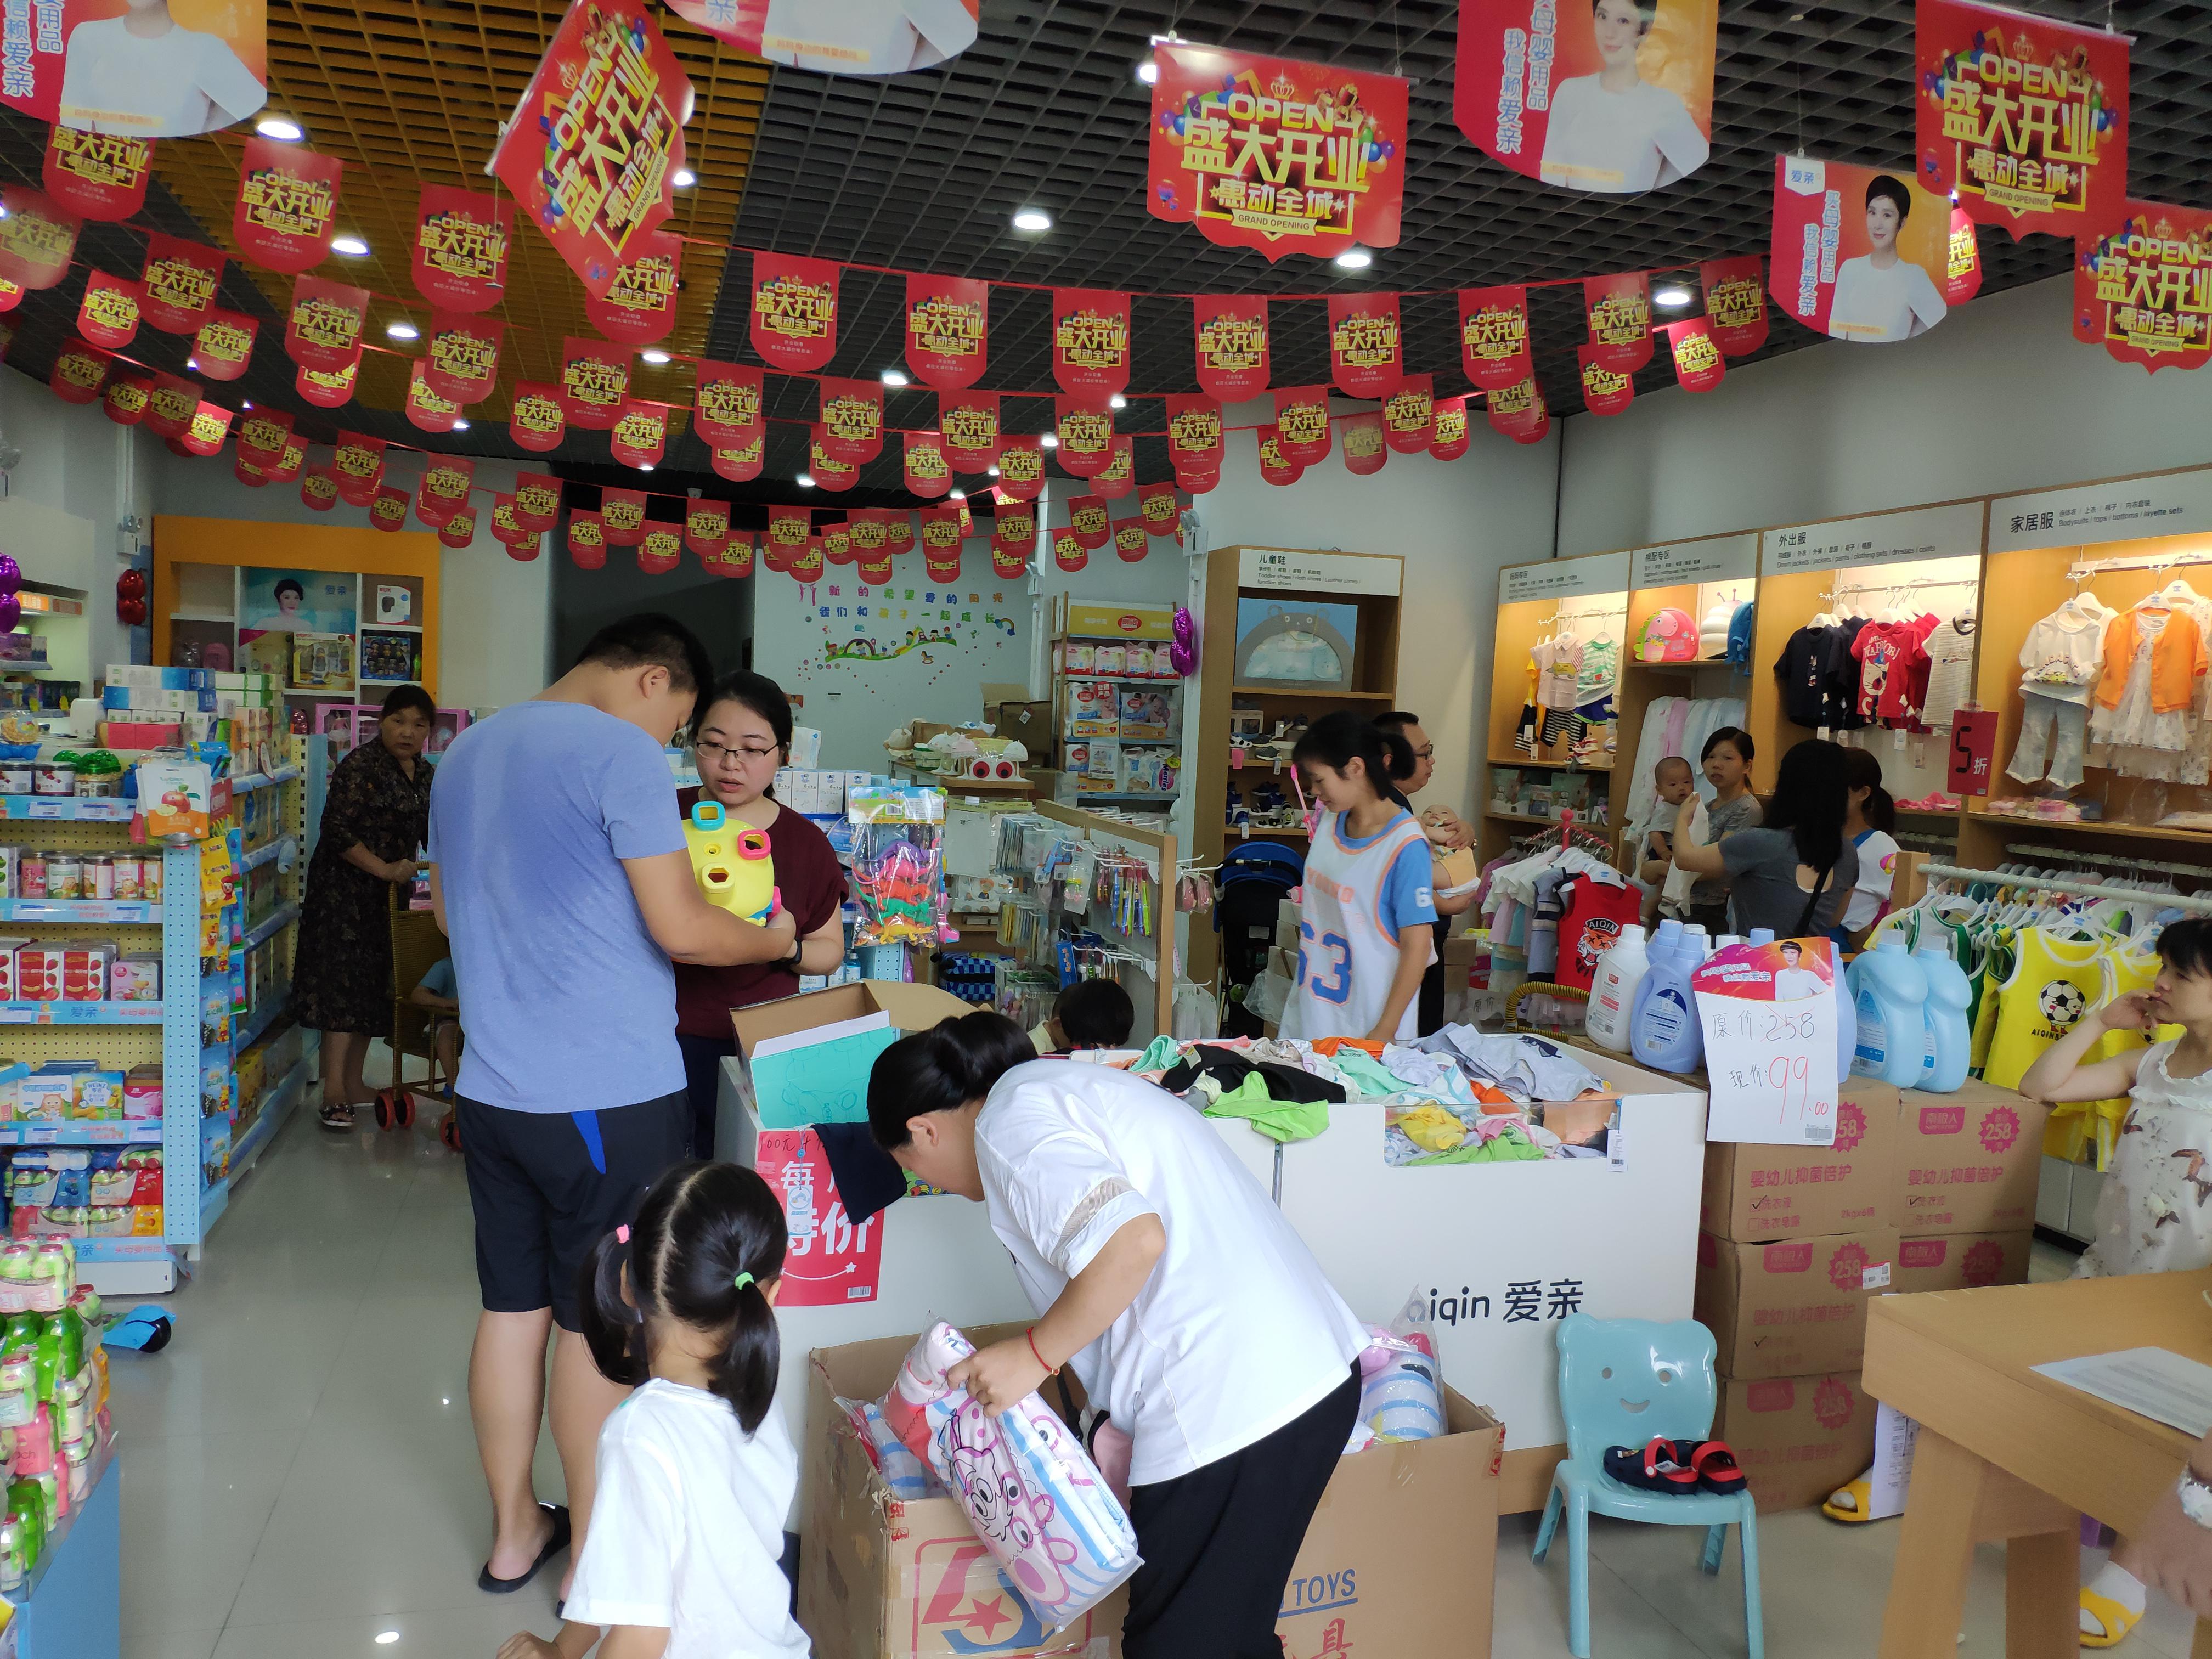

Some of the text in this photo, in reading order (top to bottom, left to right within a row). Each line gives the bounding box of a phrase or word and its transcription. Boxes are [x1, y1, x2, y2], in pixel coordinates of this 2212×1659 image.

[36, 0, 62, 52] 用品
[1528, 0, 1555, 110] 母婴用品
[1979, 53, 2068, 98] OPEN
[554, 44, 613, 151] OPEN
[1497, 28, 1526, 154] 我信赖爱亲
[1227, 95, 1334, 133] OPEN
[1943, 80, 2100, 165] 盛大开业
[554, 36, 659, 237] 盛大开业
[1181, 116, 1371, 192] 盛大开业
[1791, 169, 1815, 185] 爱亲
[1972, 149, 2069, 195] 惠动全城
[633, 155, 664, 219] GRAND OPENING
[1218, 178, 1334, 220] 惠动全城
[1990, 188, 2049, 207] GRAND OPENING
[1238, 214, 1310, 230] GRAND OPENING
[1821, 191, 1841, 283] 买母婴用品
[2128, 235, 2199, 264] OPEN
[613, 265, 675, 295] 大开业
[1799, 223, 1819, 315] 我信赖爱亲
[775, 283, 819, 297] OPEN
[2096, 256, 2212, 313] 盛大开业
[755, 293, 835, 321] 盛大开业
[927, 303, 969, 315] OPEN
[1477, 312, 1513, 323] OPEN
[1591, 307, 1649, 330] 盛大开业
[910, 312, 985, 339] 盛大开业
[1073, 317, 1113, 329] OPEN
[1214, 321, 1251, 331] OPEN
[1347, 319, 1383, 330] OPEN
[1464, 320, 1526, 343] 盛大开业
[1057, 327, 1127, 351] 盛大开业
[1199, 331, 1267, 353] 盛大开业
[1334, 329, 1398, 351] 盛大开业
[2011, 512, 2055, 533] 家居服
[2058, 517, 2089, 526] Bodysuits
[2112, 512, 2138, 521] bottoms
[2169, 506, 2183, 515] sets
[1778, 532, 1807, 548] 外出服
[1259, 554, 1286, 565] 儿童鞋
[1835, 555, 1850, 563] pants
[1854, 551, 1875, 560] clothing
[1161, 763, 1170, 792] Merries
[1589, 920, 1616, 933] AIQIN
[1837, 1119, 1858, 1138] 58
[1984, 1123, 2012, 1141] 258
[1751, 1164, 1852, 1188] 婴幼儿抑菌倍护
[1834, 1259, 1861, 1279] 258
[1503, 1279, 1584, 1323] 爱亲
[1292, 1568, 1356, 1606] TOYS
